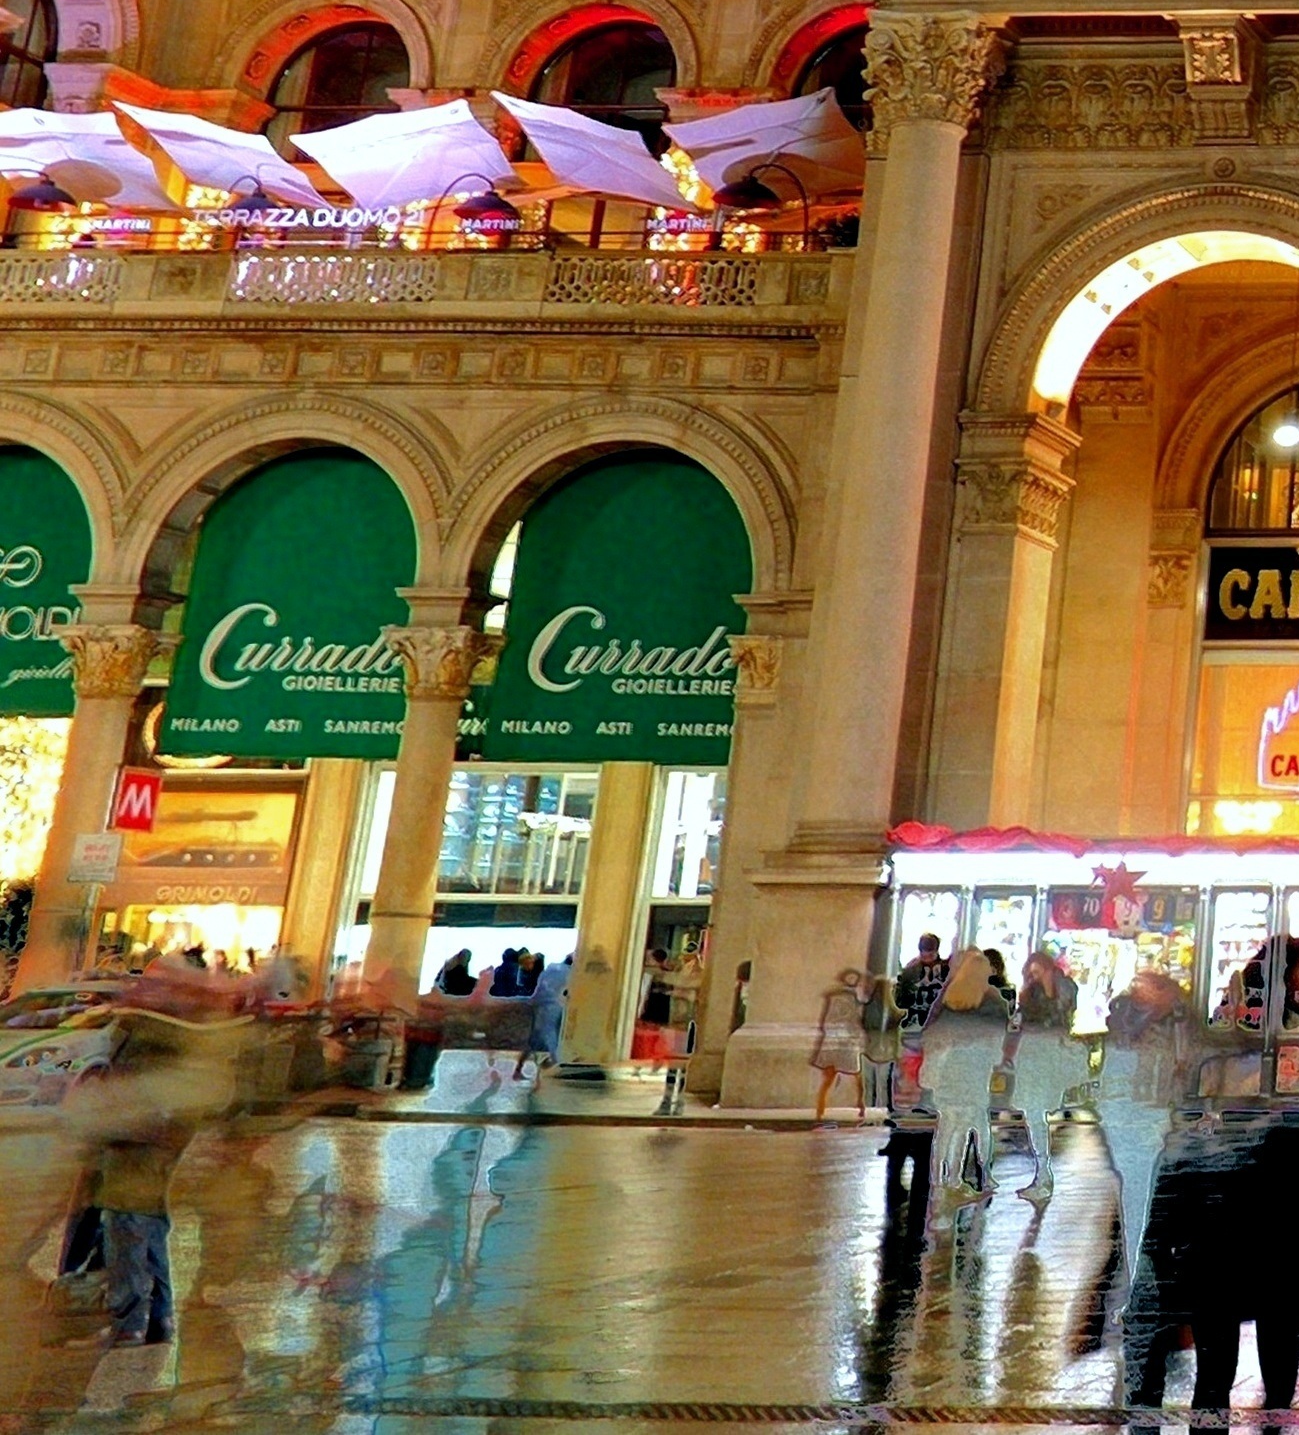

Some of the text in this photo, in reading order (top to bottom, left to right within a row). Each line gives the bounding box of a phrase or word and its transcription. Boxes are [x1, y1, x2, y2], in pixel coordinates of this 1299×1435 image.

[92, 220, 151, 231] MARTINI
[193, 208, 310, 228] TERRAZZA
[312, 208, 400, 227] DUOMO
[461, 218, 519, 231] MARTINI
[647, 218, 708, 231] MARTINI
[199, 602, 405, 690] Currado
[527, 605, 735, 693] Currado
[281, 675, 401, 693] GIOIELLERIE
[611, 678, 733, 696] GIOIELLERIE
[170, 717, 240, 733] MILANO
[264, 718, 300, 733] ASTI
[501, 720, 734, 737] MILANO ASTI SANREM
[118, 783, 152, 818] M
[156, 885, 259, 902] GRIMOLDI
